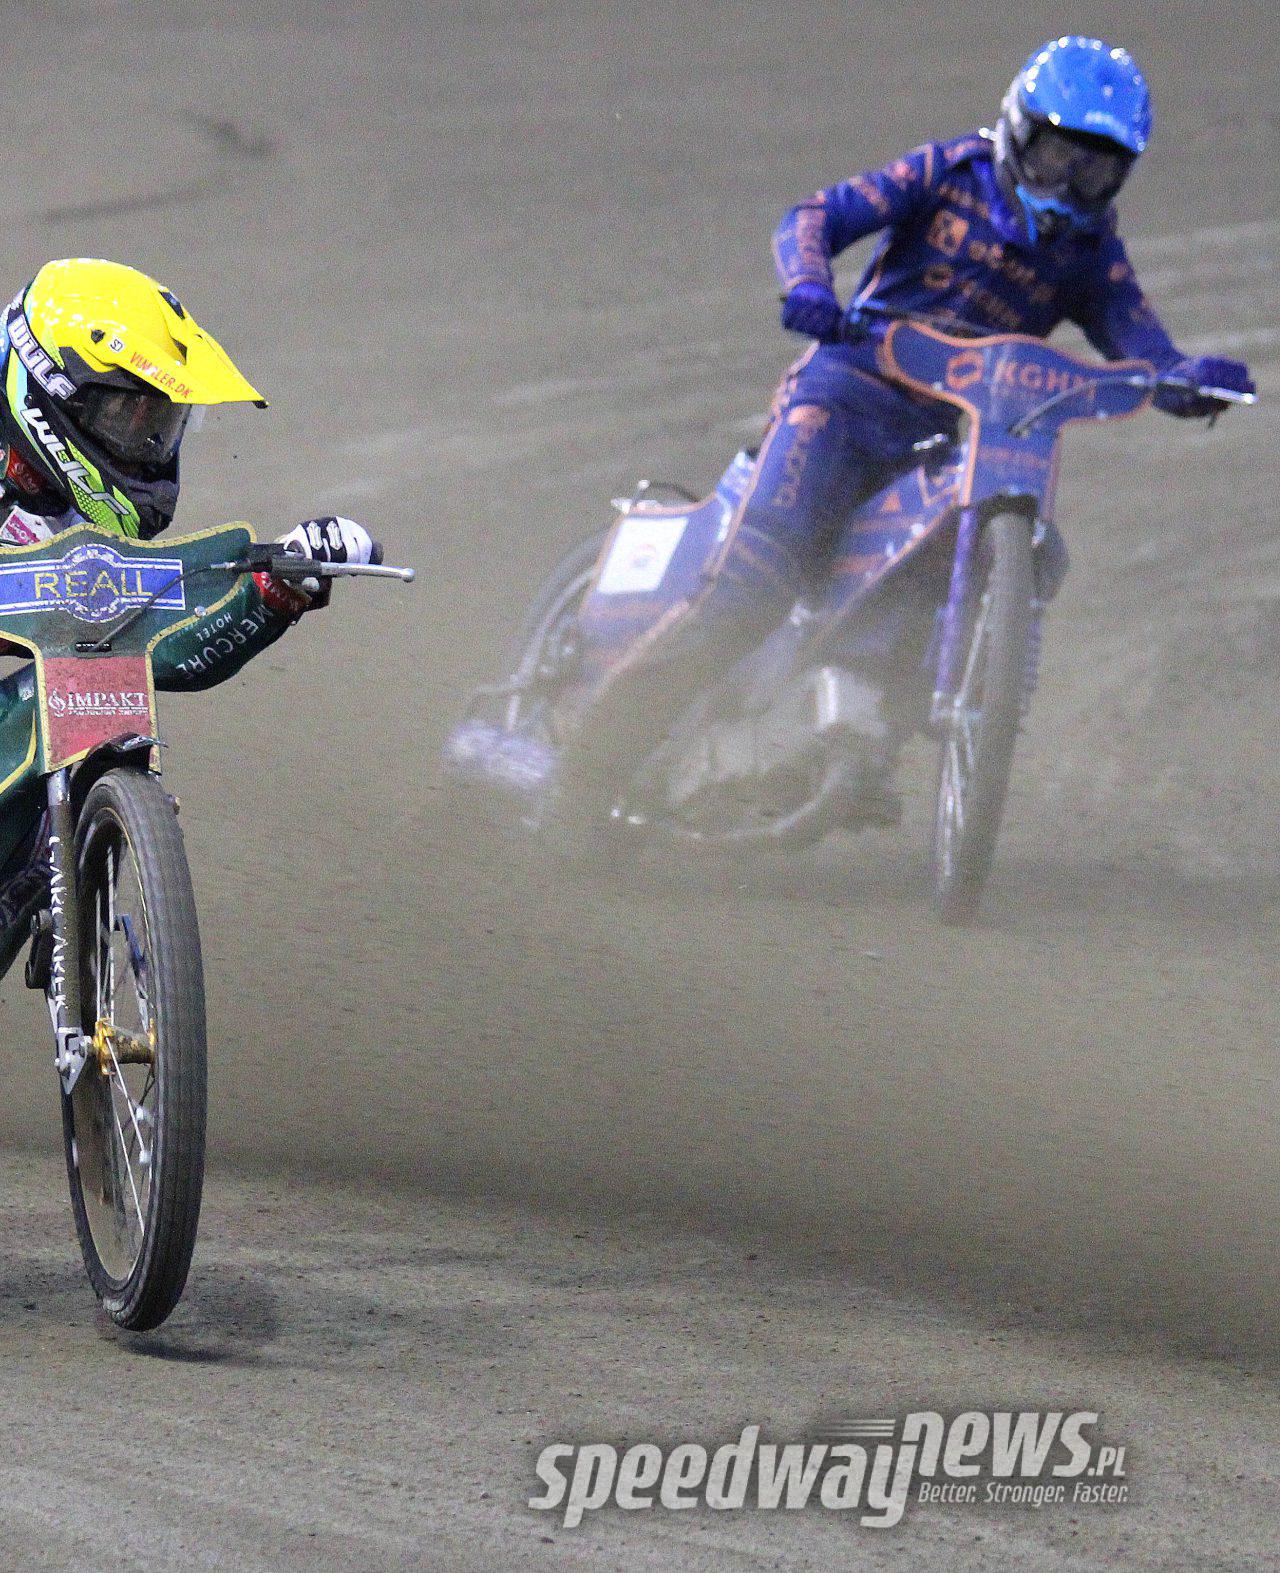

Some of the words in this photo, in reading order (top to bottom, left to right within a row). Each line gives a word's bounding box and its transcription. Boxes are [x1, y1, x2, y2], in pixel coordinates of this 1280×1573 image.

[6, 313, 78, 401] WULF
[20, 406, 131, 516] WULF
[34, 570, 153, 600] REALL
[197, 612, 233, 642] HOTEL
[67, 691, 147, 707] IMPAKT
